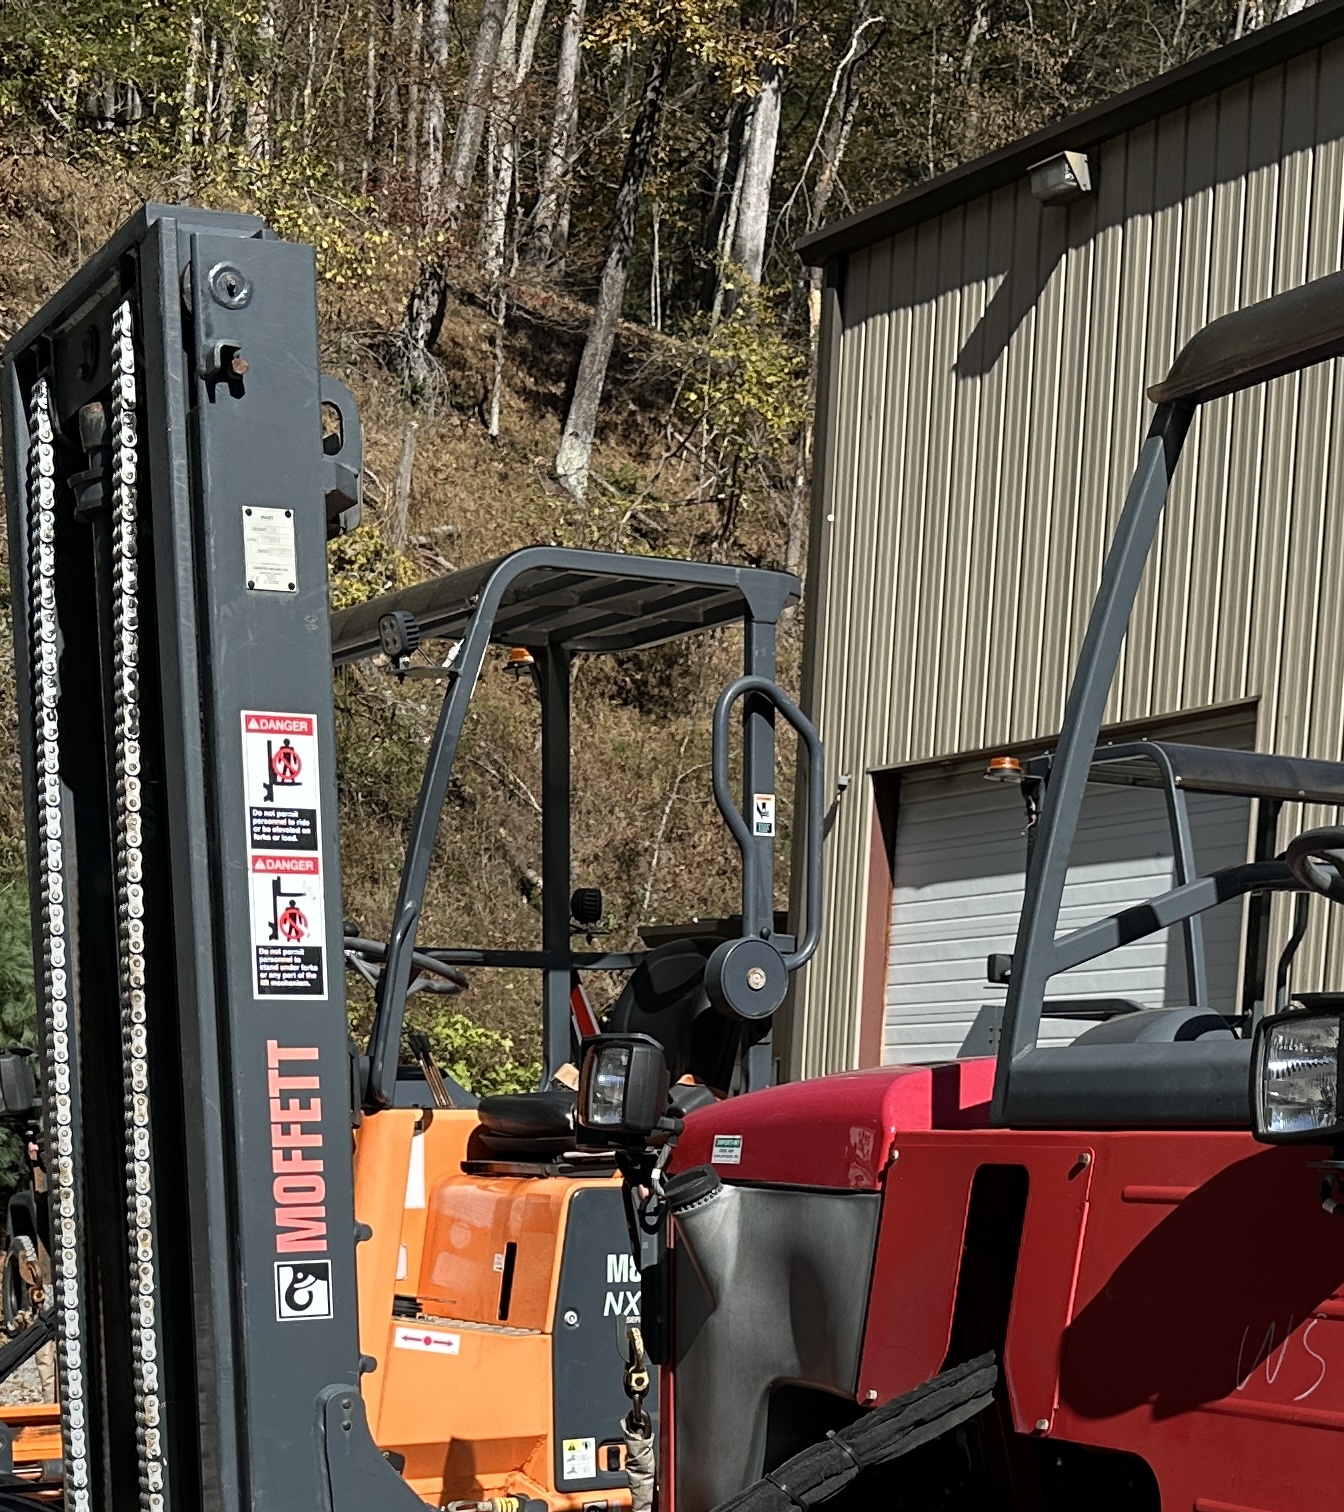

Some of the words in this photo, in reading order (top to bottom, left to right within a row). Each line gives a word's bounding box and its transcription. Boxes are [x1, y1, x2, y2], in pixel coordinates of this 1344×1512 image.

[259, 718, 309, 732] DANGER
[265, 859, 315, 872] DANGER
[266, 1039, 328, 1253] MOFFETT
